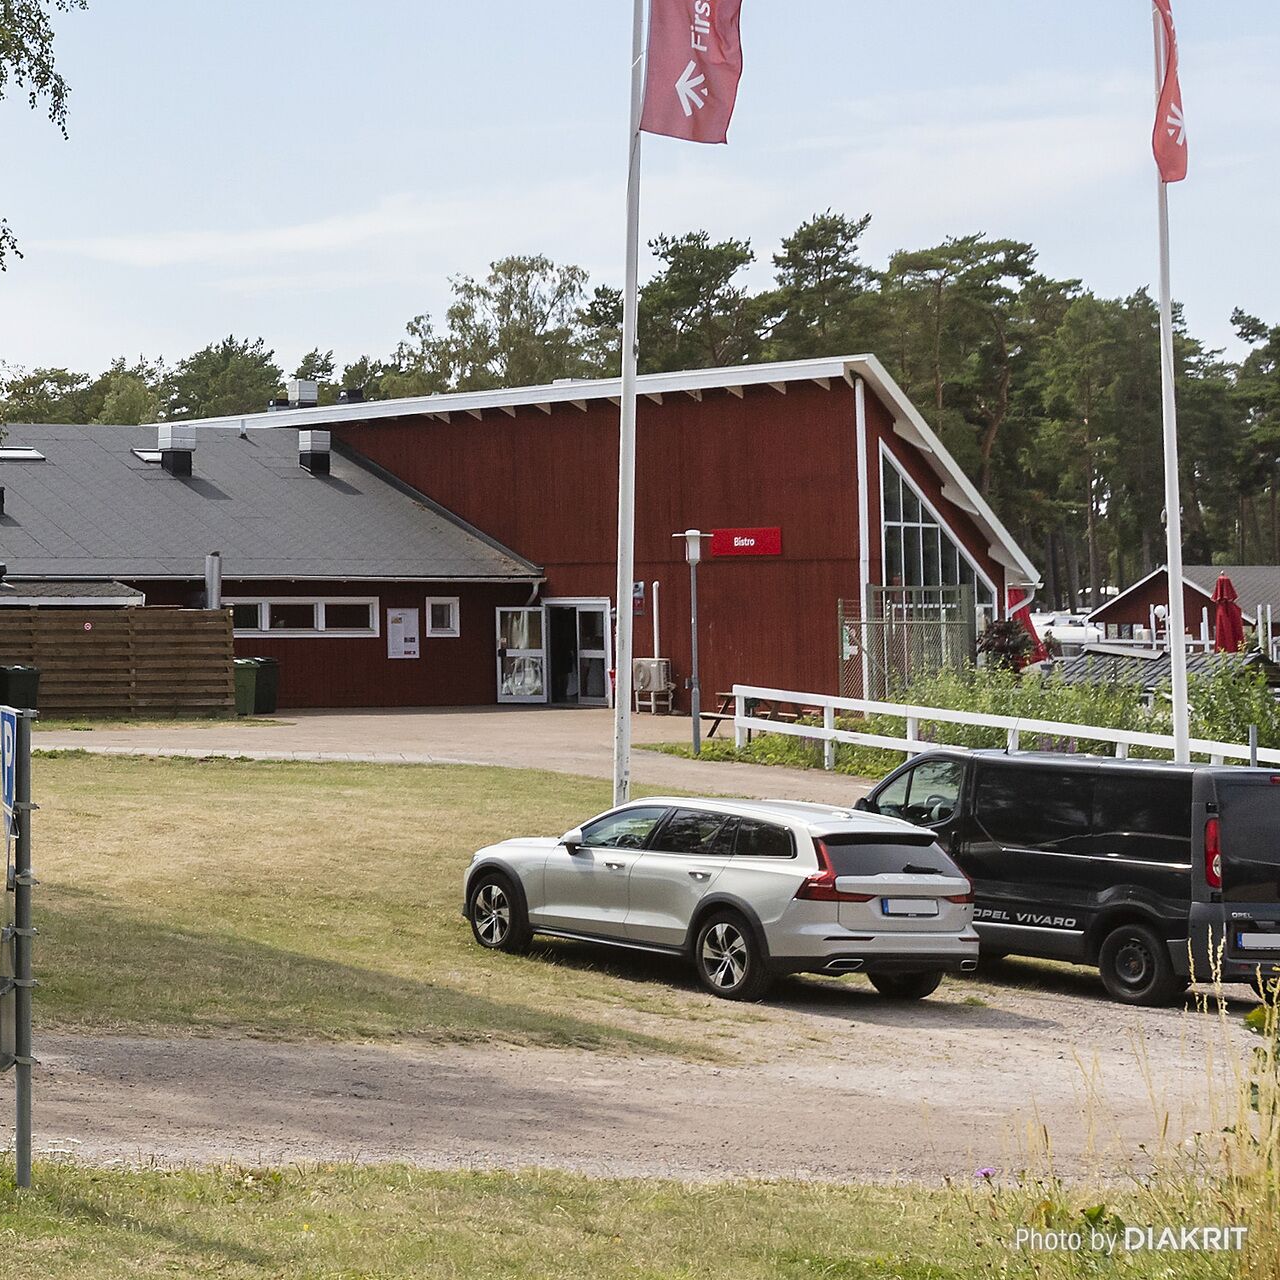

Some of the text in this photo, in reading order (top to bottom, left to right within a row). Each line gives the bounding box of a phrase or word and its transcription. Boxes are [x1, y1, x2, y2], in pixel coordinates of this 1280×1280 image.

[734, 536, 755, 546] Bistro
[5, 721, 13, 795] P
[973, 908, 1077, 927] OPEL VIVARO
